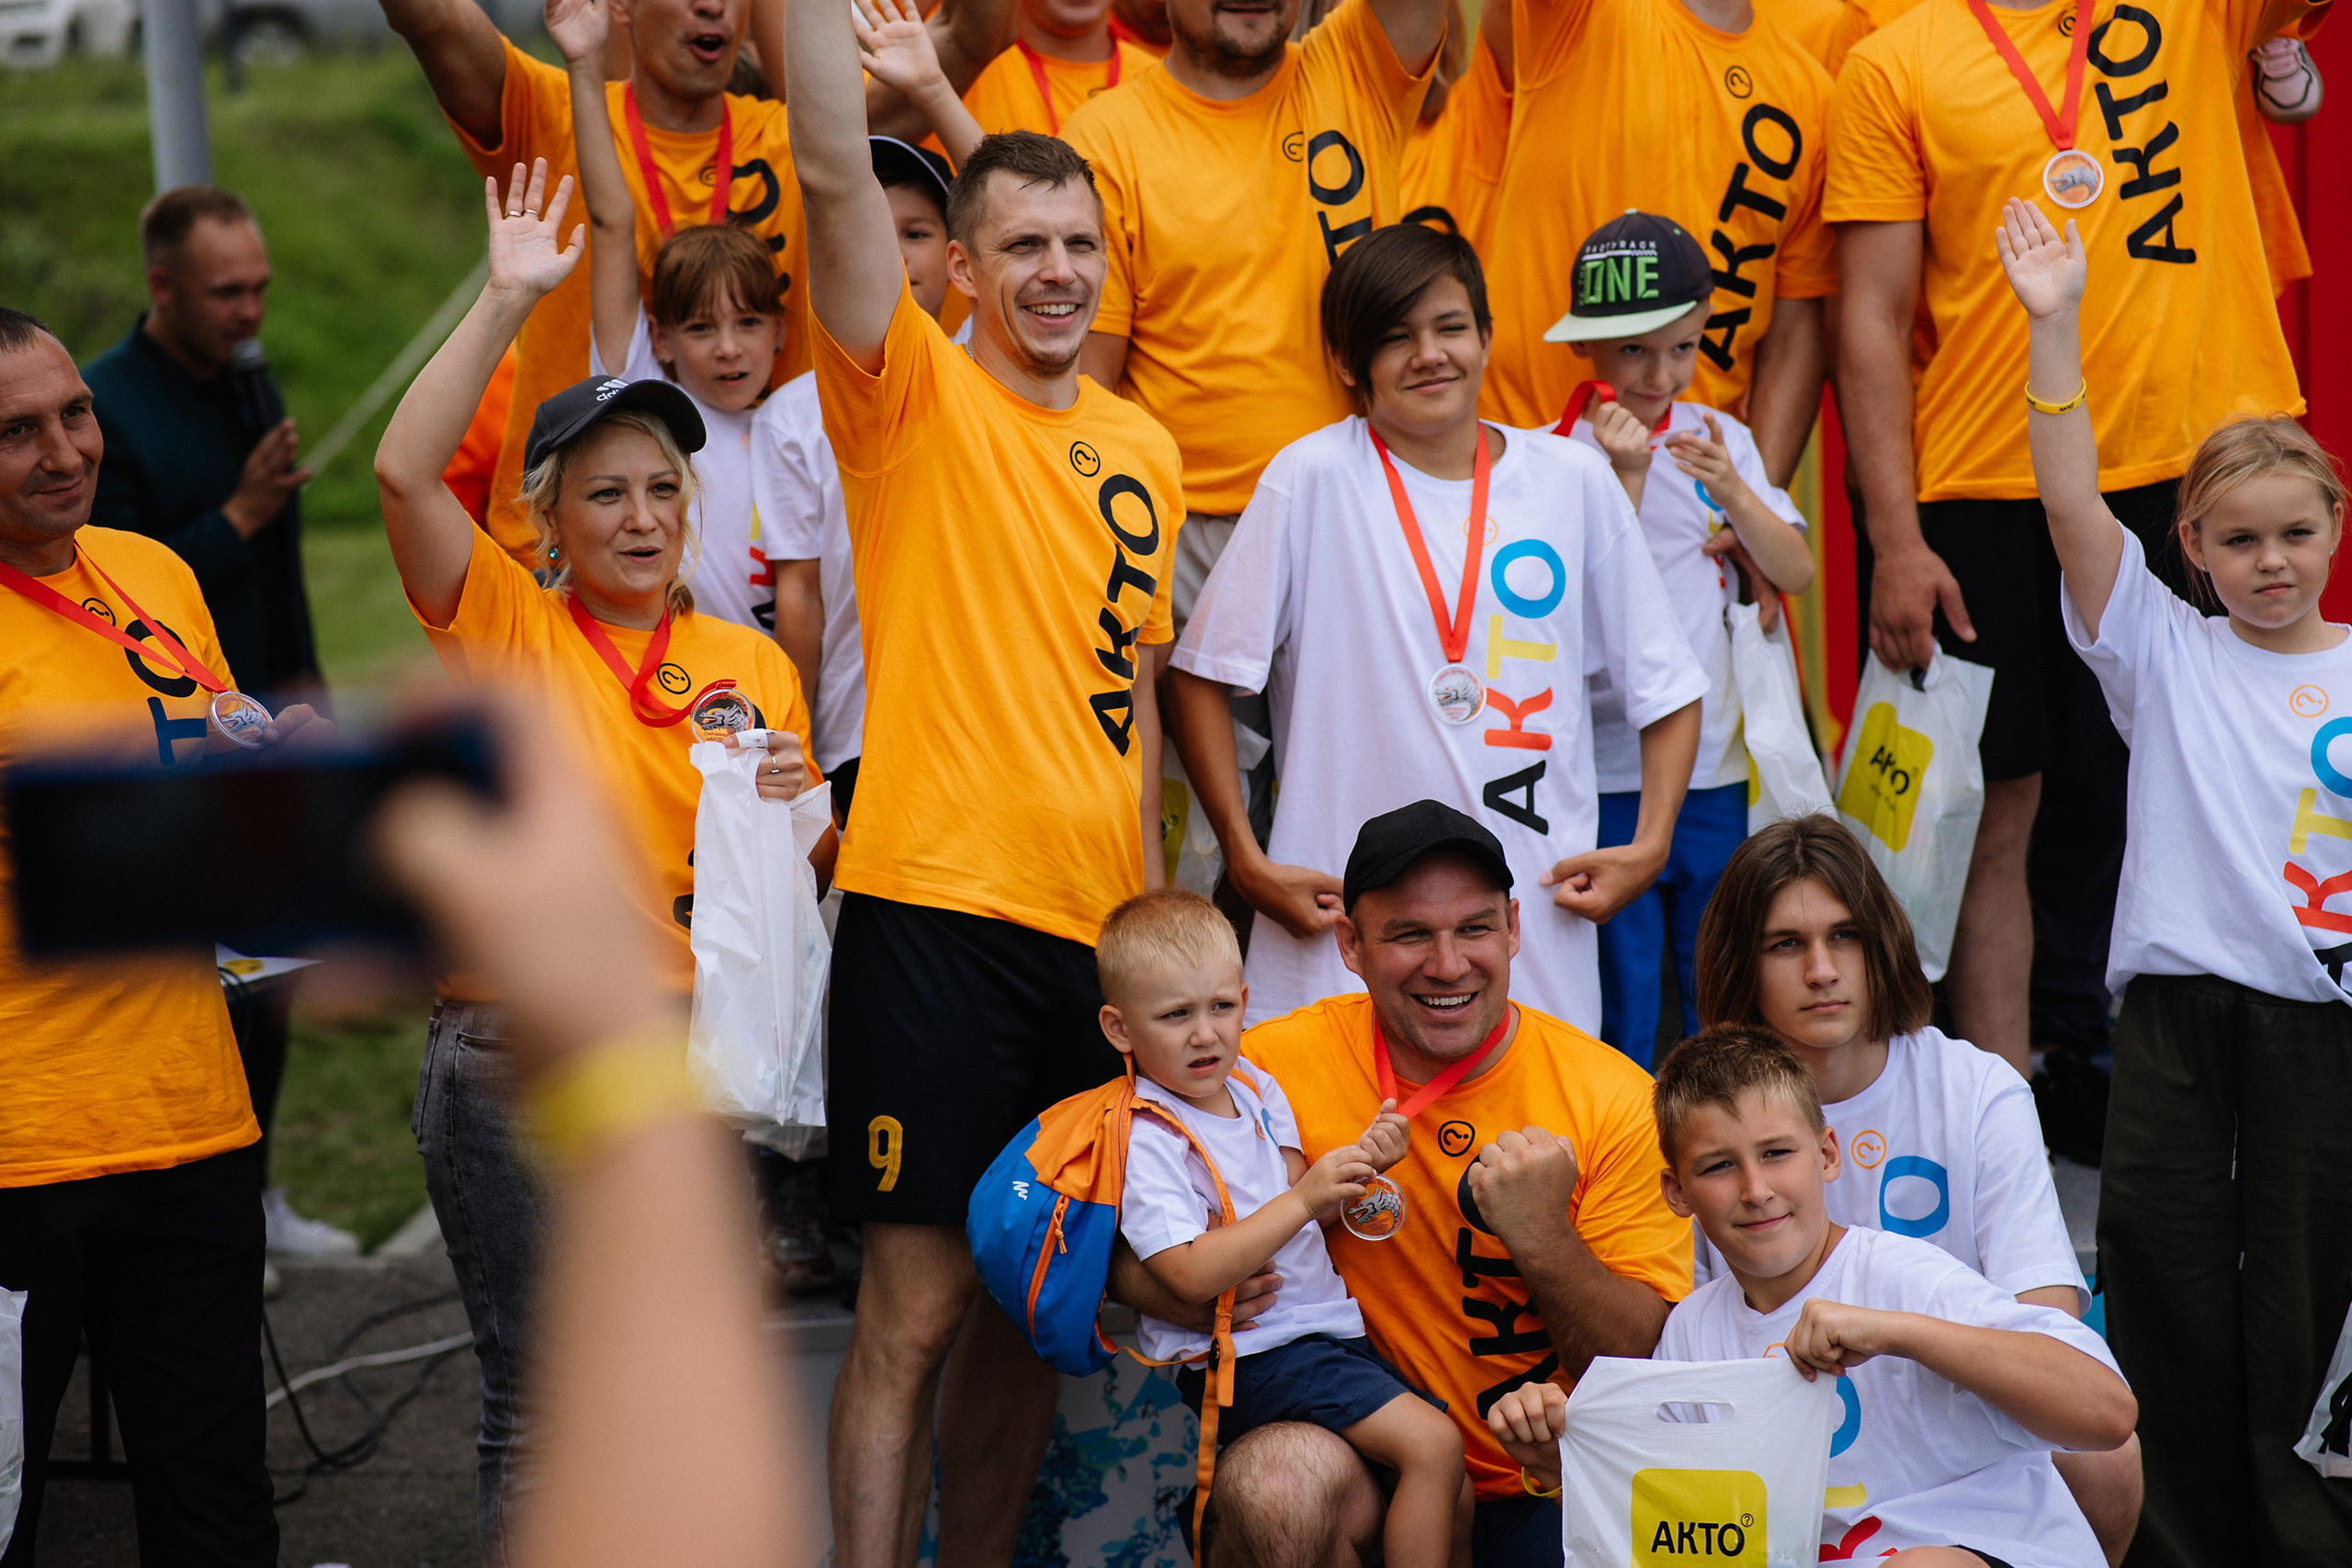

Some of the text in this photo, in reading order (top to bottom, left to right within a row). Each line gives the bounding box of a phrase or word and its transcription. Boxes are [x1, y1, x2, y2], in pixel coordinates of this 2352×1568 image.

[1307, 130, 1372, 268] ТО
[2086, 5, 2197, 264] АКТО
[1583, 255, 1659, 305] ONE
[1699, 103, 1803, 372] АКТО
[1089, 473, 1159, 756] АКТО
[1483, 538, 1566, 836] АКТО
[123, 618, 208, 766] ТО
[867, 1114, 903, 1192] 9
[1651, 1520, 1745, 1557] АКТО
